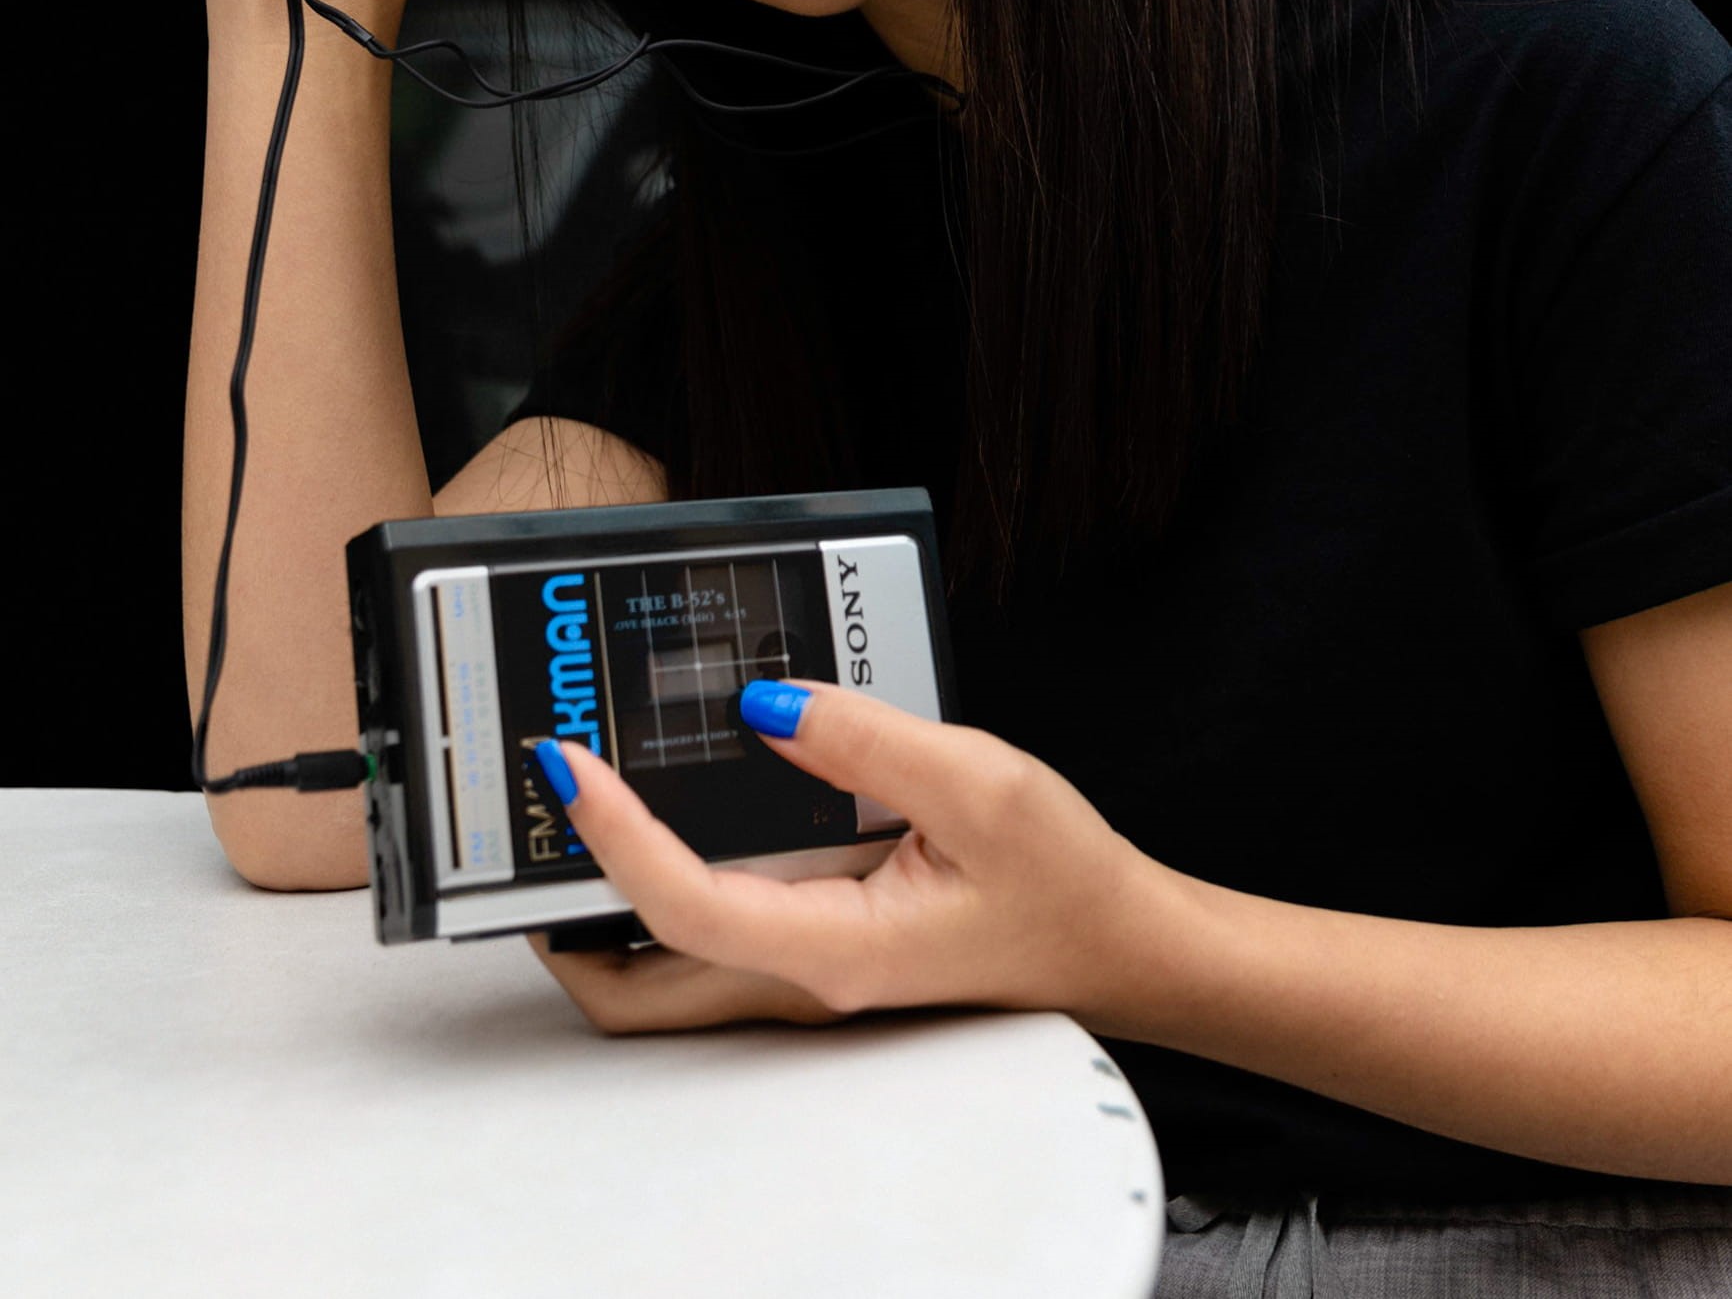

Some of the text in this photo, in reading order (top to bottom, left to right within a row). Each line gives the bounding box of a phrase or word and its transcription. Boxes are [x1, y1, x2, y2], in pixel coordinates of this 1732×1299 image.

[626, 596, 666, 613] THE
[615, 619, 638, 630] OVE
[837, 555, 872, 686] SONY
